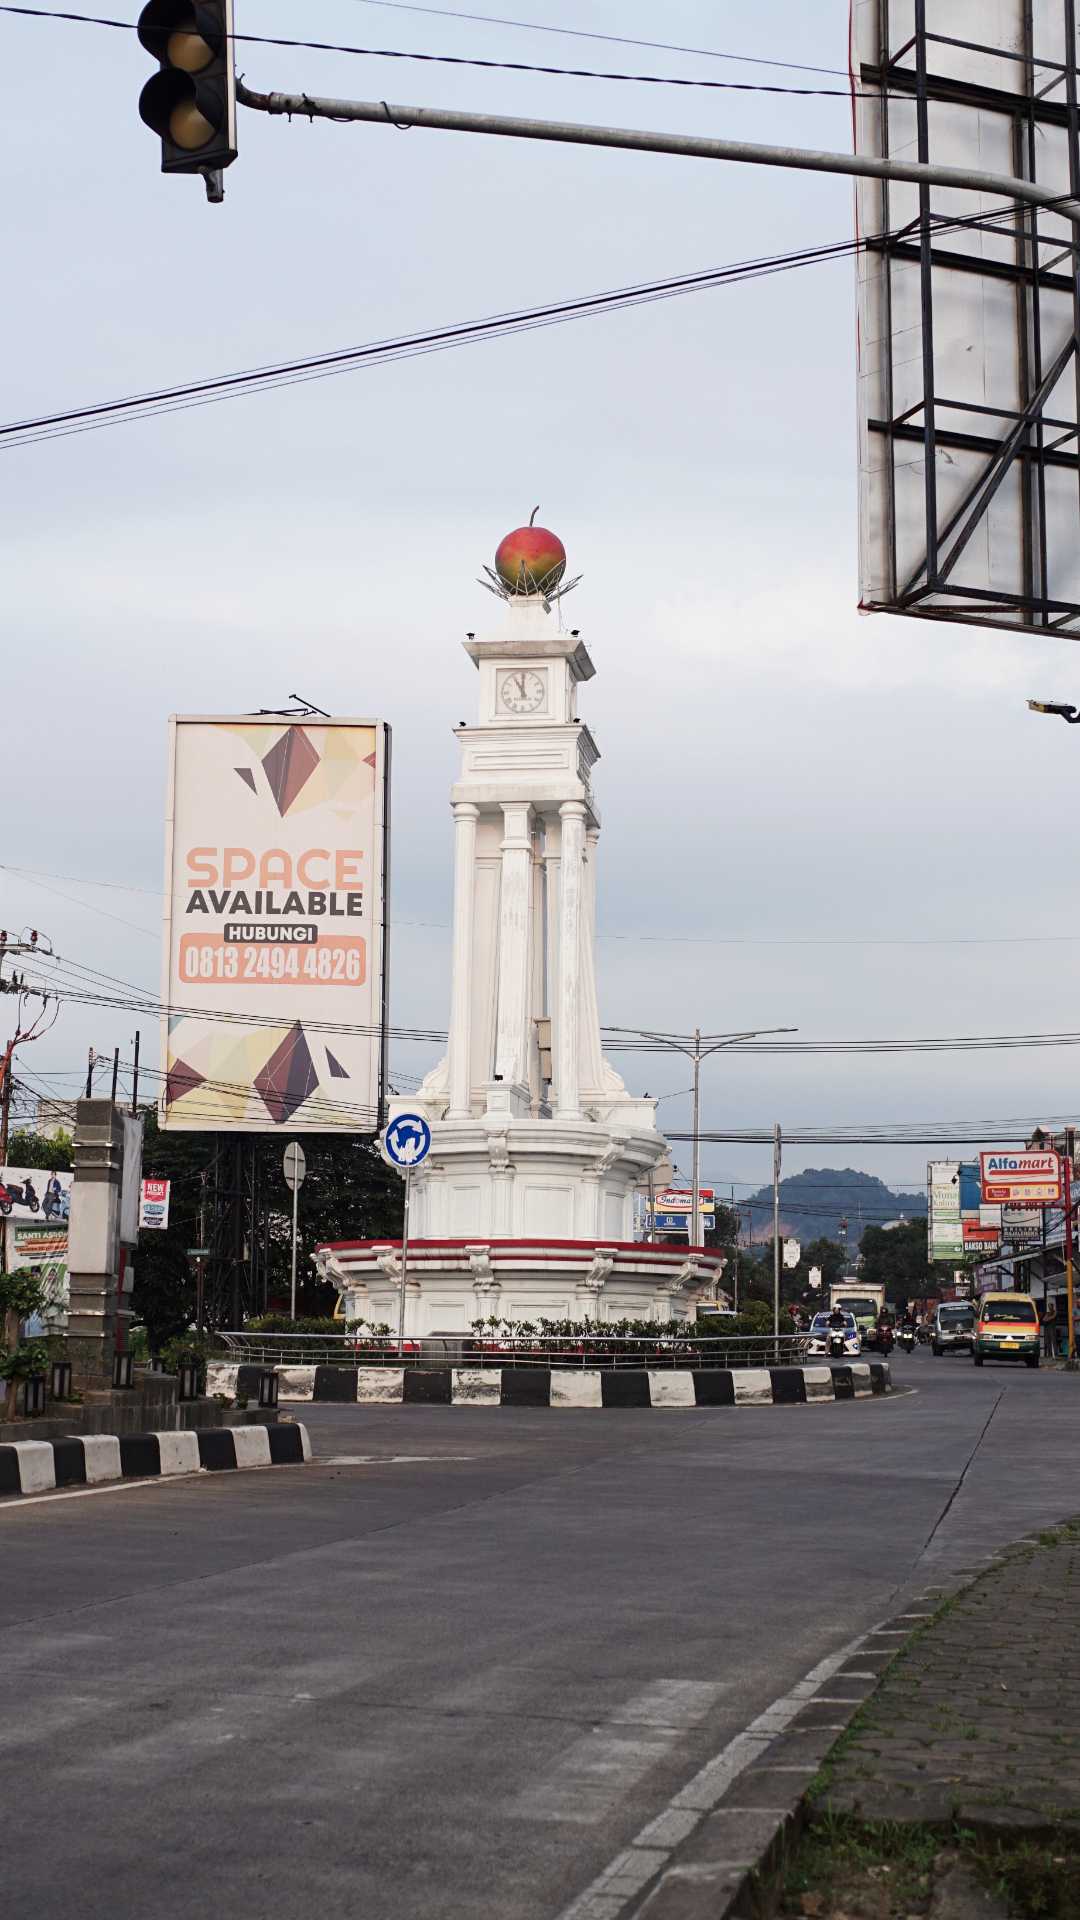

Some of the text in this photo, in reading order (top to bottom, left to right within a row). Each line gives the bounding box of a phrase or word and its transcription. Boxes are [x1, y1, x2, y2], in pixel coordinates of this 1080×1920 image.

[186, 847, 364, 890] SPACE
[185, 889, 363, 916] AVAILABLE
[228, 926, 313, 941] HUBUNGI
[184, 946, 360, 981] 0813 2494 4826
[988, 1157, 1054, 1170] Alfamart
